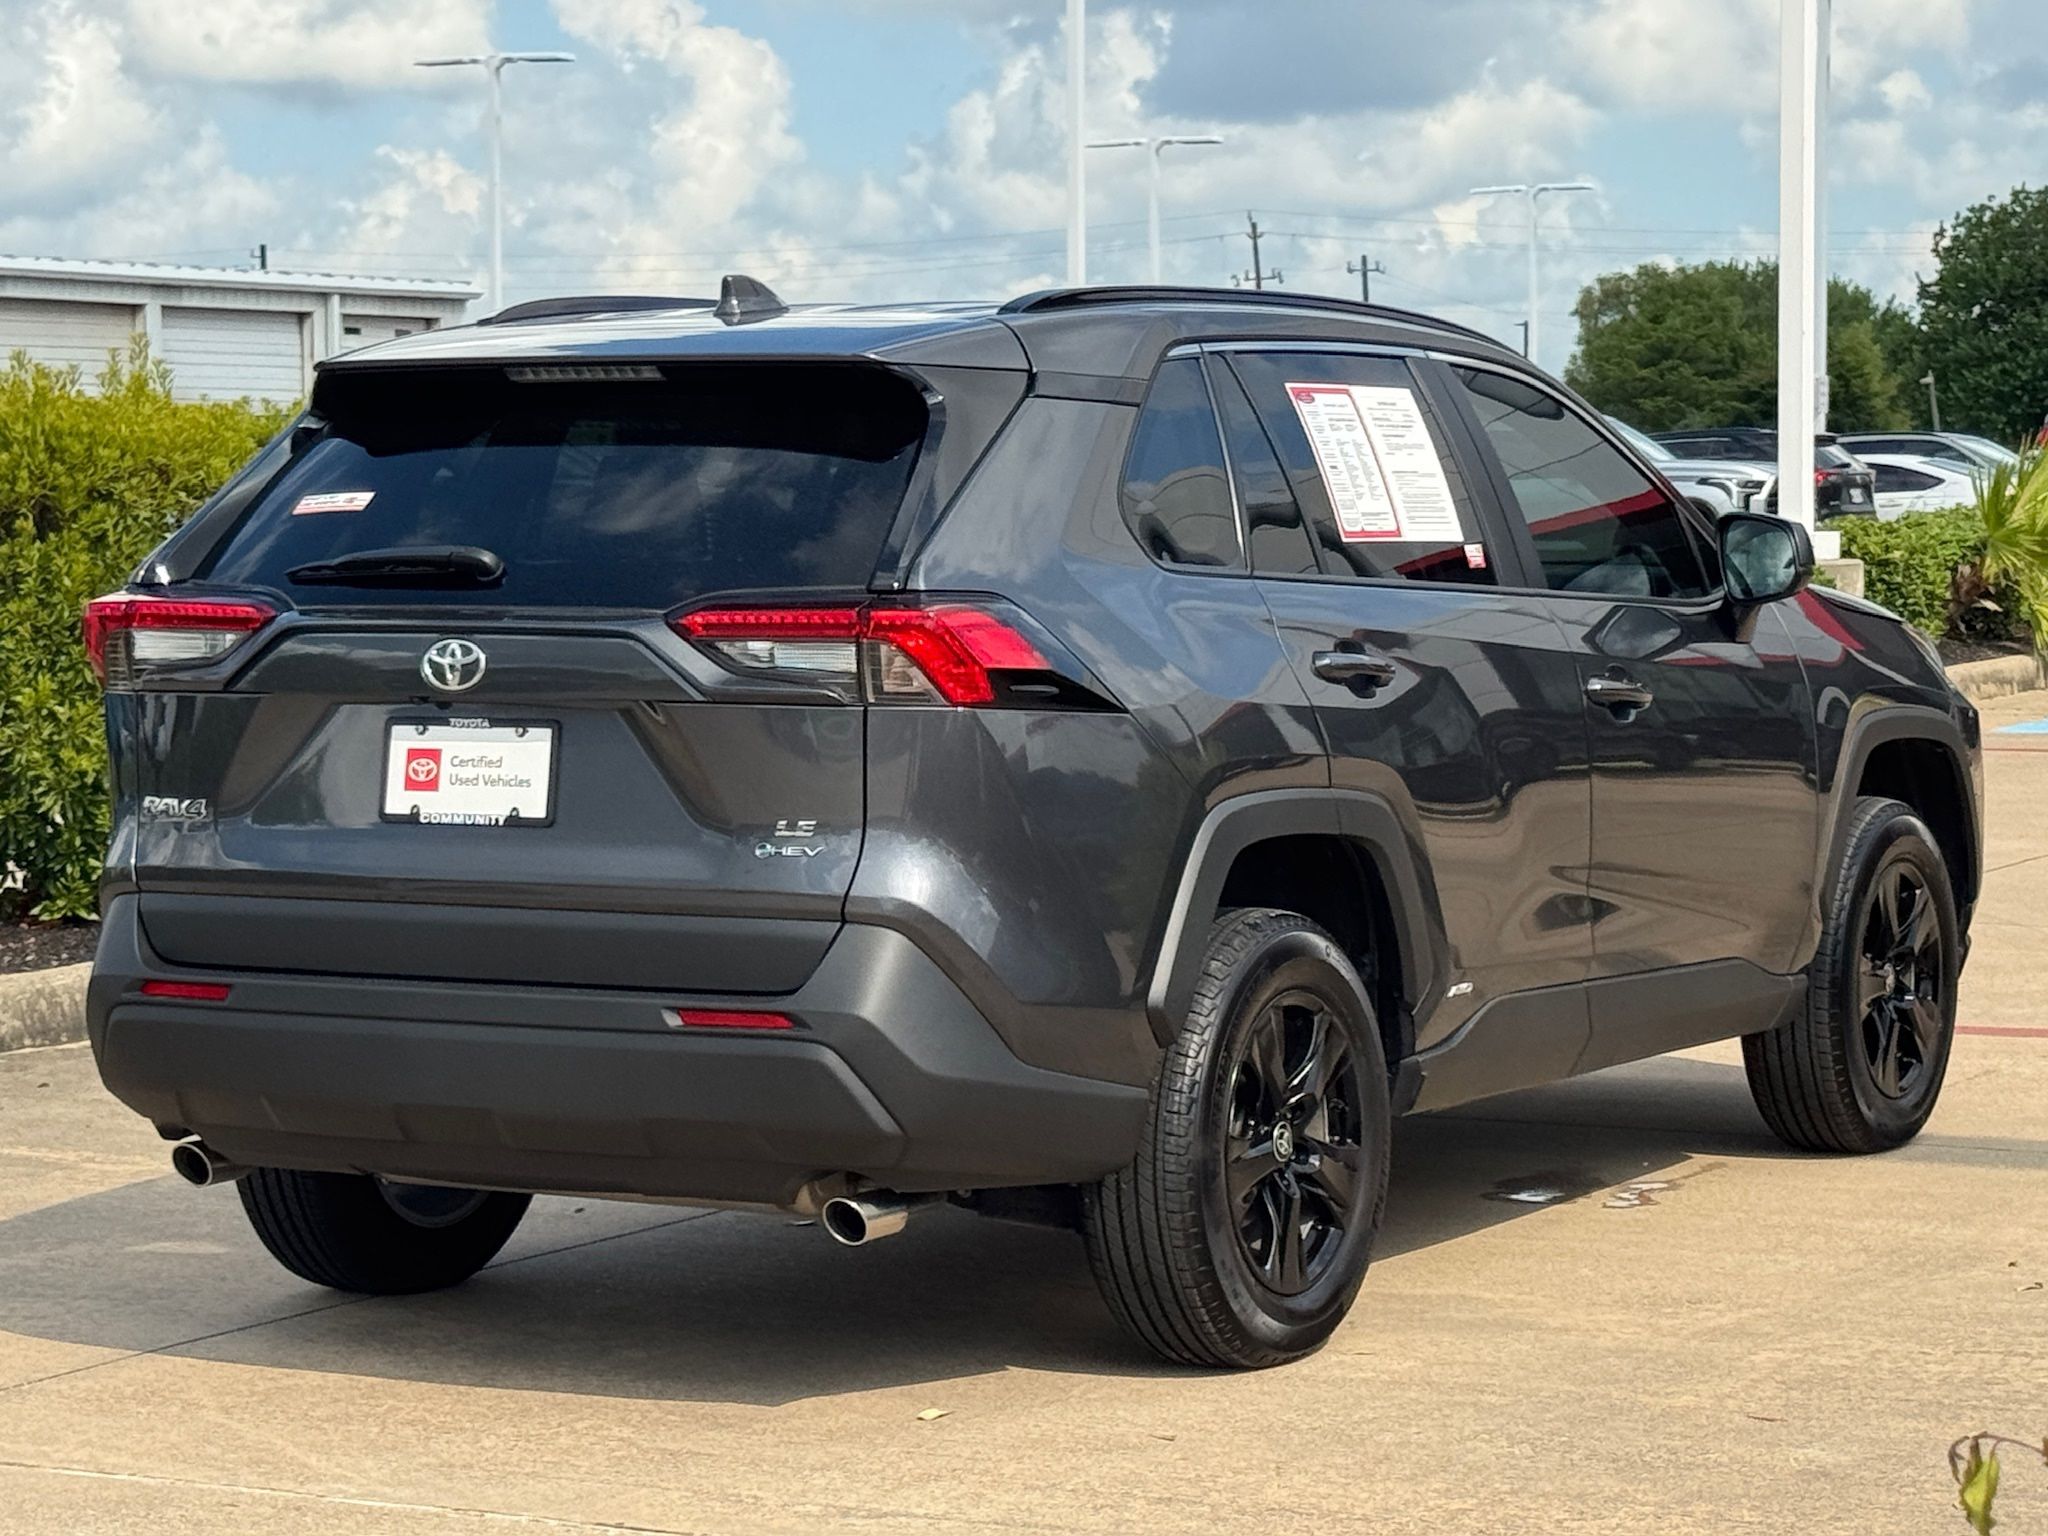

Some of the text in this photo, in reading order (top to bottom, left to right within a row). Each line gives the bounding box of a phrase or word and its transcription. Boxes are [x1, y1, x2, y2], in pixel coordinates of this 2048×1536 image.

[448, 717, 491, 728] TOYOTA
[450, 755, 503, 768] Certified
[449, 773, 532, 788] Used Vehicles
[143, 795, 208, 819] RAV4
[418, 812, 508, 826] COMMUNITY
[774, 819, 818, 837] LE
